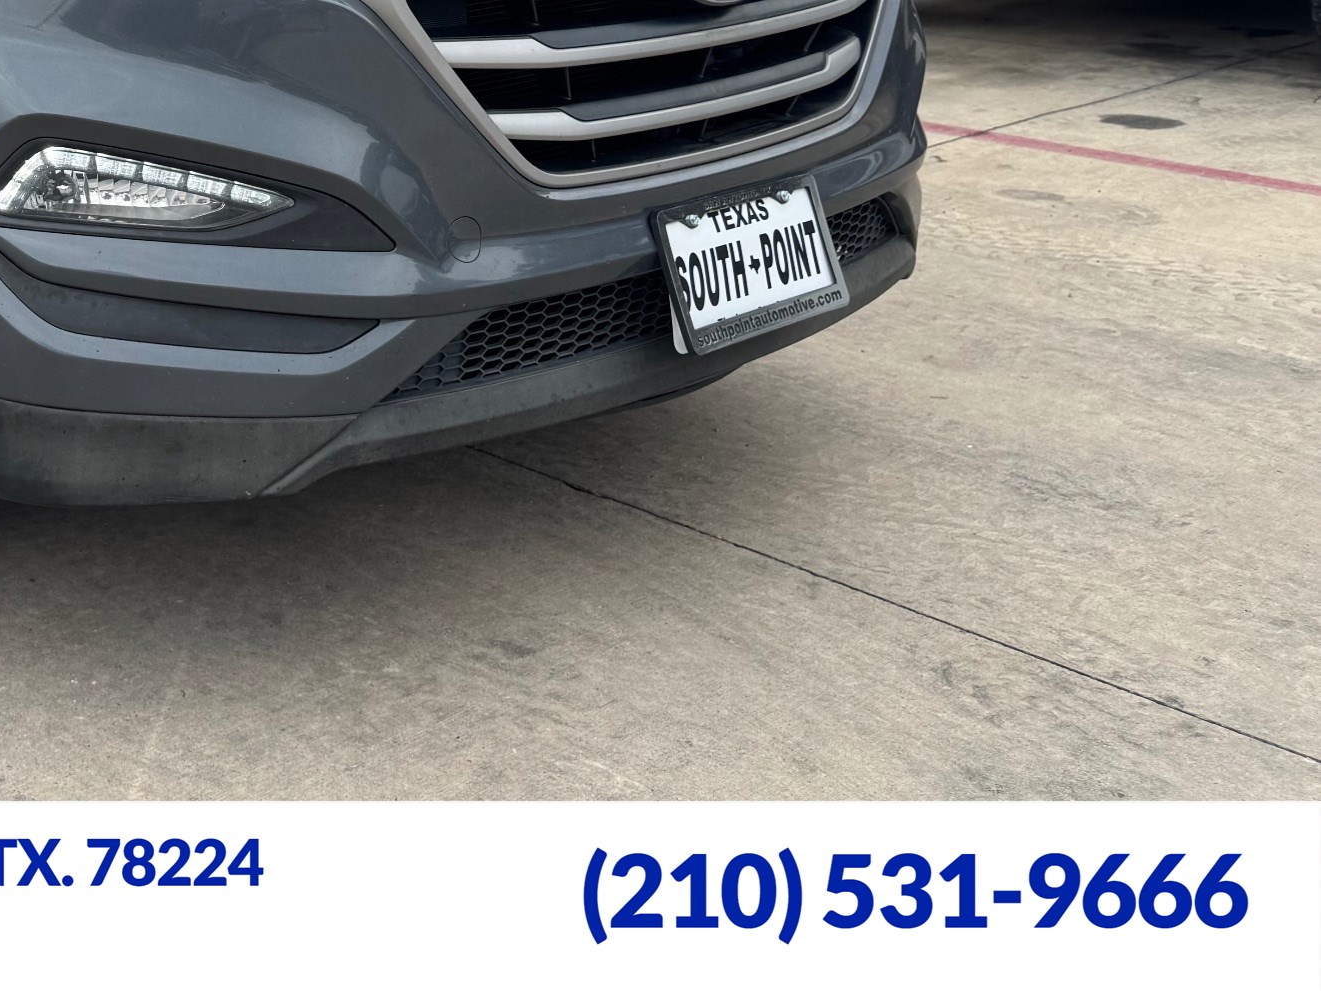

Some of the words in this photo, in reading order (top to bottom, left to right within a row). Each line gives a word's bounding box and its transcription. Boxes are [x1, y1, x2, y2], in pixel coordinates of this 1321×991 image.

[708, 199, 770, 233] TEXAS
[674, 240, 749, 313] SOUTH
[759, 219, 822, 290] POINT
[697, 288, 843, 348] southpointautomotive.com
